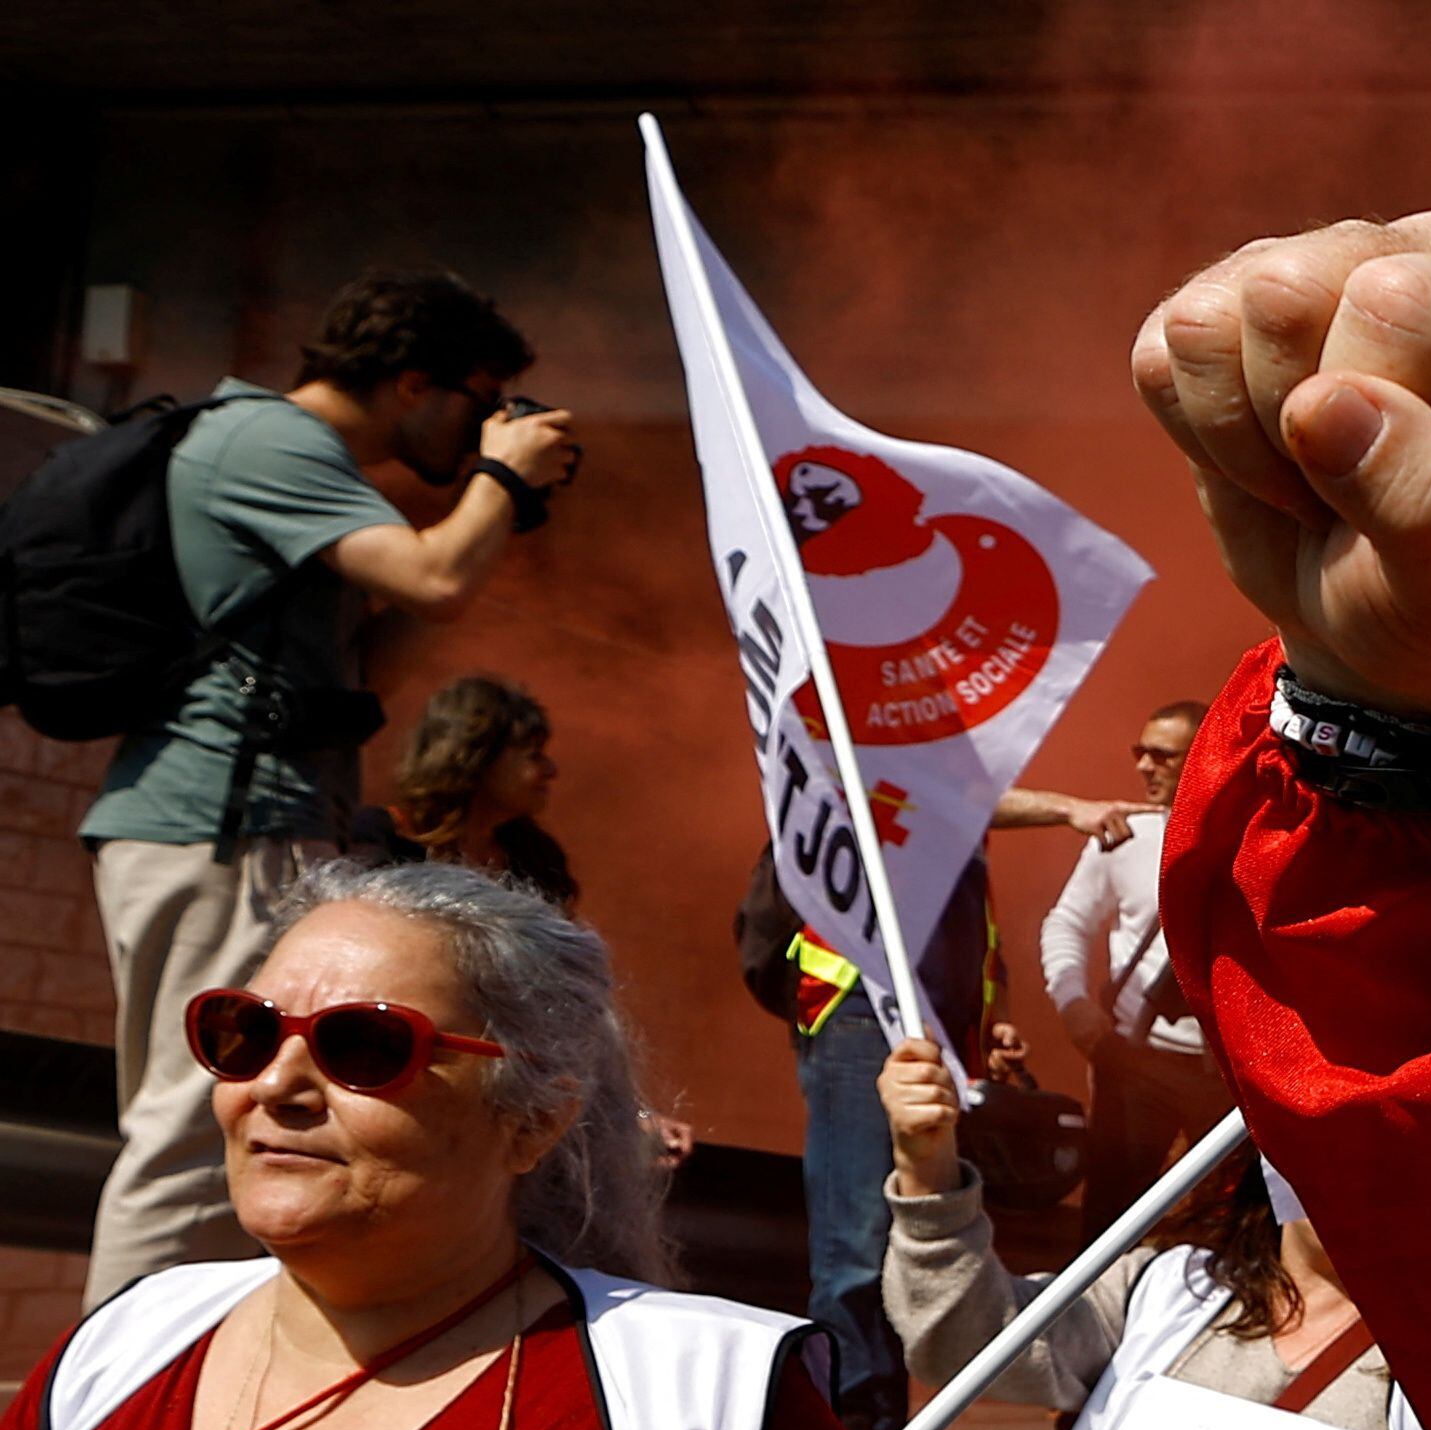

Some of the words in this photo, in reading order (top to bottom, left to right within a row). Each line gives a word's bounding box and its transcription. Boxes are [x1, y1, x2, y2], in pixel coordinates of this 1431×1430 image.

[866, 690, 958, 730] ACTION
[955, 621, 1038, 705] SOCIALE
[881, 637, 965, 687] SANTÉ
[954, 614, 989, 649] ET
